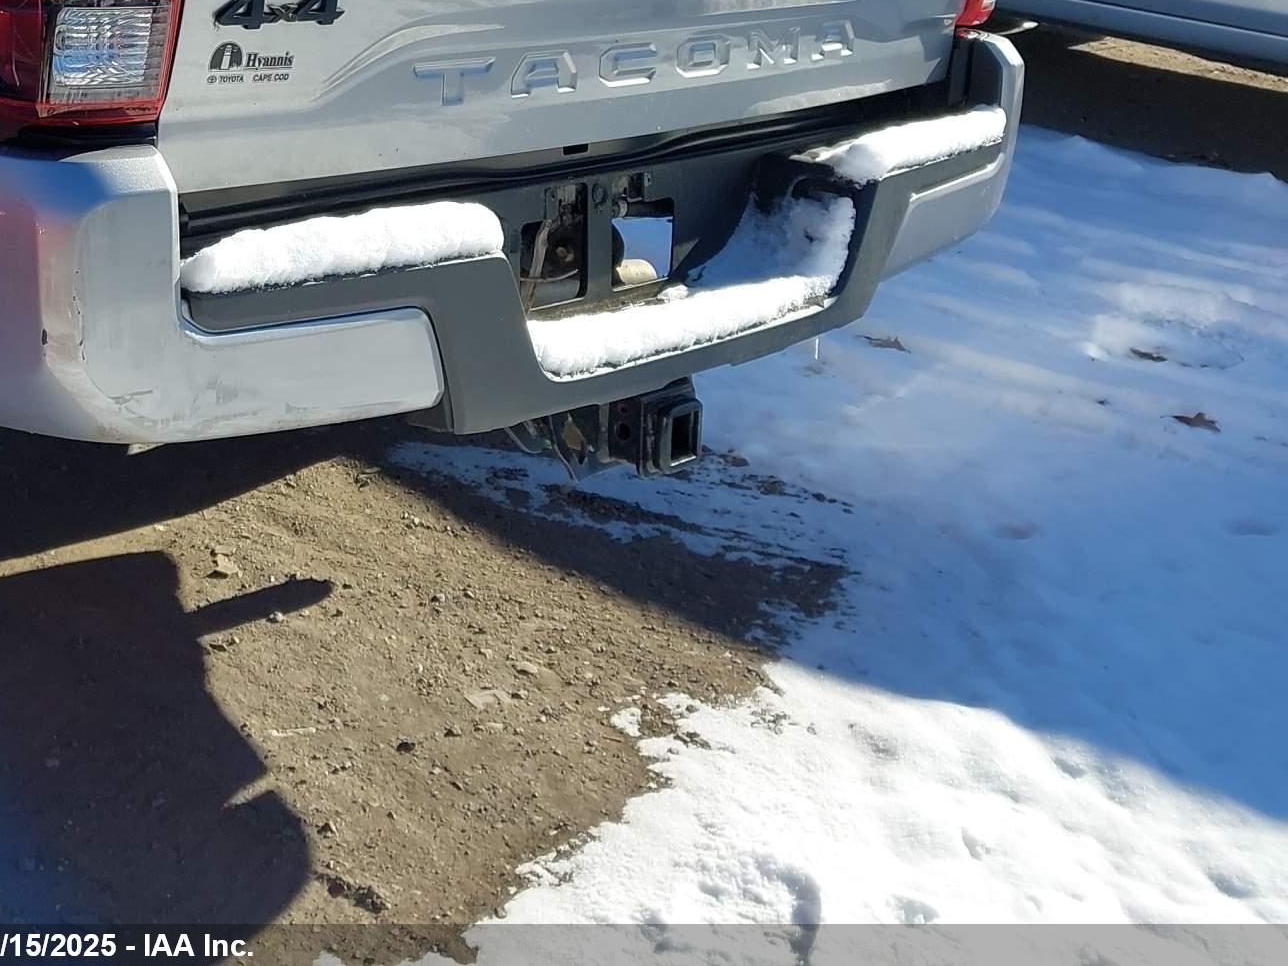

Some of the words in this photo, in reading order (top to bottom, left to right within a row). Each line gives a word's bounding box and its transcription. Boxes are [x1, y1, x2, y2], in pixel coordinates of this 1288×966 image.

[245, 51, 294, 70] Hyannis
[413, 19, 854, 106] TACOMA
[219, 75, 244, 83] TOYOTA
[253, 74, 273, 82] CAPE
[274, 73, 289, 81] COD
